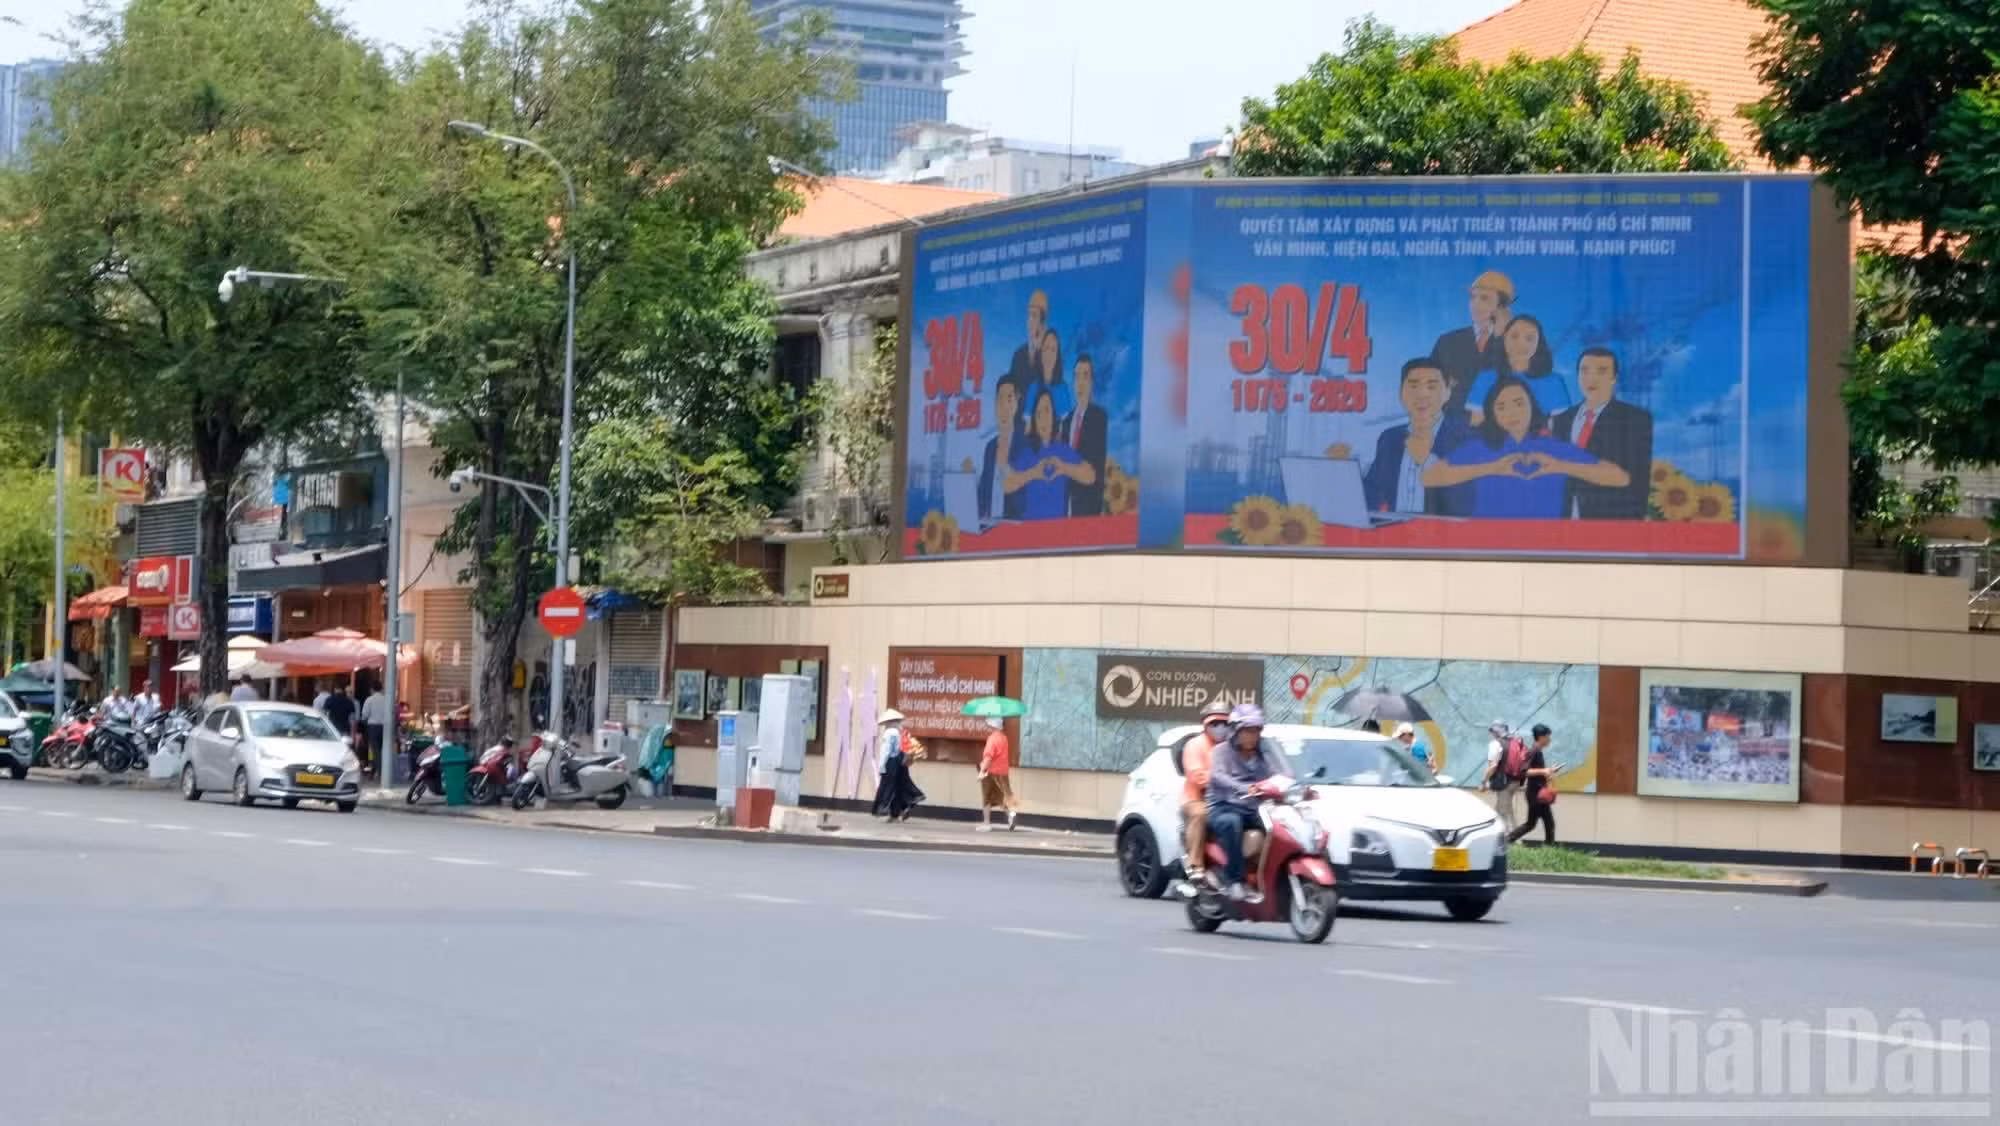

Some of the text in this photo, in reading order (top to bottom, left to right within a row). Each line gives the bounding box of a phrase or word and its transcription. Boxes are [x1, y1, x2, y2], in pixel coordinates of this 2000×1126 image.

[1240, 210, 1692, 236] QUYẾT TÂM XÂY DỰNG VÀ PHÁT TRIỂN THÀNH PHỐ HỒ CHÍ MINH
[1254, 237, 1282, 256] VĂN
[1334, 238, 1367, 260] HIỆN
[1629, 237, 1675, 256] PHÚC!
[1229, 280, 1372, 375] 30/4
[924, 309, 984, 400] 30/4
[115, 461, 136, 481] K
[181, 610, 194, 625] K
[1146, 671, 1172, 681] CON
[1145, 682, 1208, 707] NHIẾP
